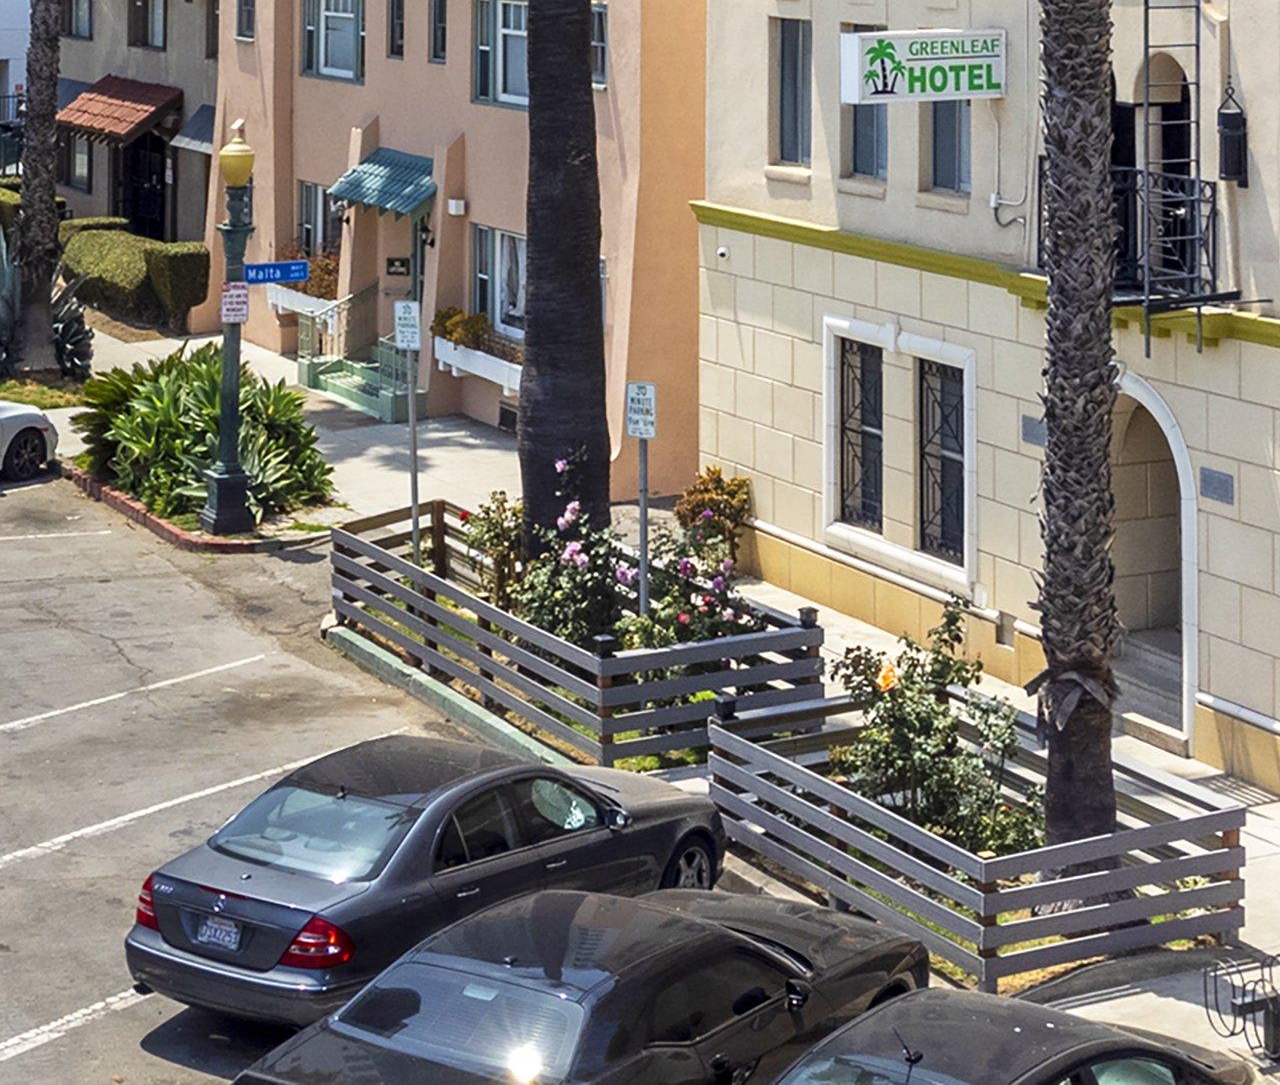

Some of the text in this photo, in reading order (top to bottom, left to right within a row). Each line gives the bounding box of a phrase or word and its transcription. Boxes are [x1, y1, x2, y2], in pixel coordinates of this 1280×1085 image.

[908, 38, 1000, 56] GREENLEAF
[907, 64, 1002, 94] HOTEL
[247, 268, 281, 280] Malta
[636, 385, 647, 396] 30
[630, 397, 652, 406] MINUTE
[629, 405, 653, 416] PARKING
